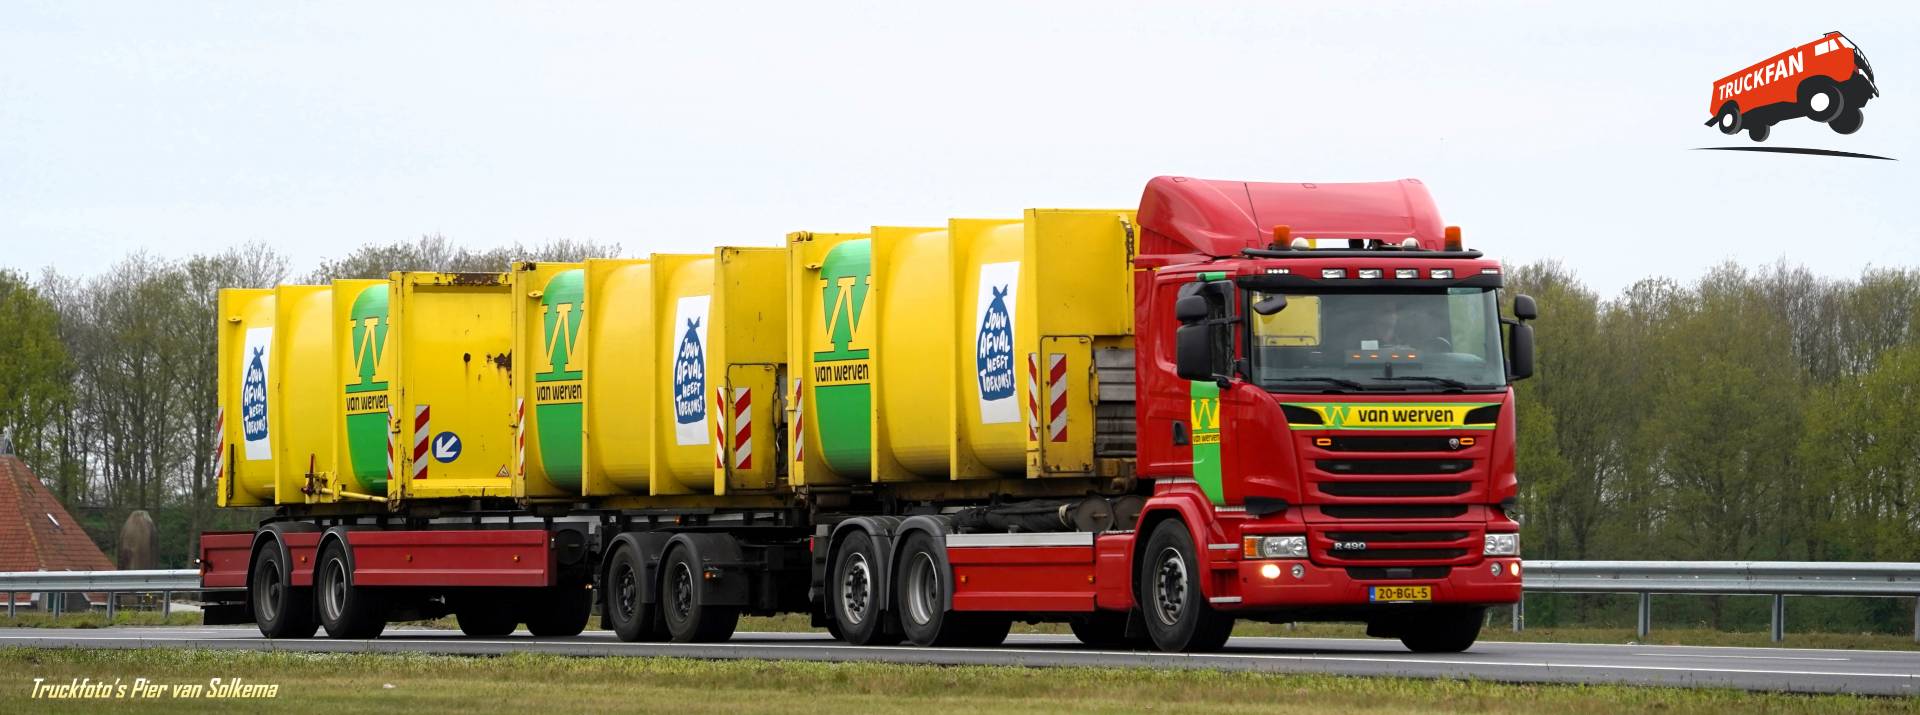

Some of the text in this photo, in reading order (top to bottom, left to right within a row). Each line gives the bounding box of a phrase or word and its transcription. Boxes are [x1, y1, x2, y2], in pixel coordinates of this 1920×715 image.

[979, 330, 1011, 358] AFVAL
[676, 358, 703, 385] AFVAL
[815, 363, 869, 382] van werven
[986, 355, 1009, 372] HEEFT
[979, 368, 1013, 393] TOEKOMST
[536, 383, 582, 401] van werven
[346, 394, 388, 412] van werven
[1358, 409, 1389, 423] van
[1392, 409, 1454, 423] werven
[1334, 541, 1367, 551] R 490
[1379, 587, 1428, 600] 20-BGL-5
